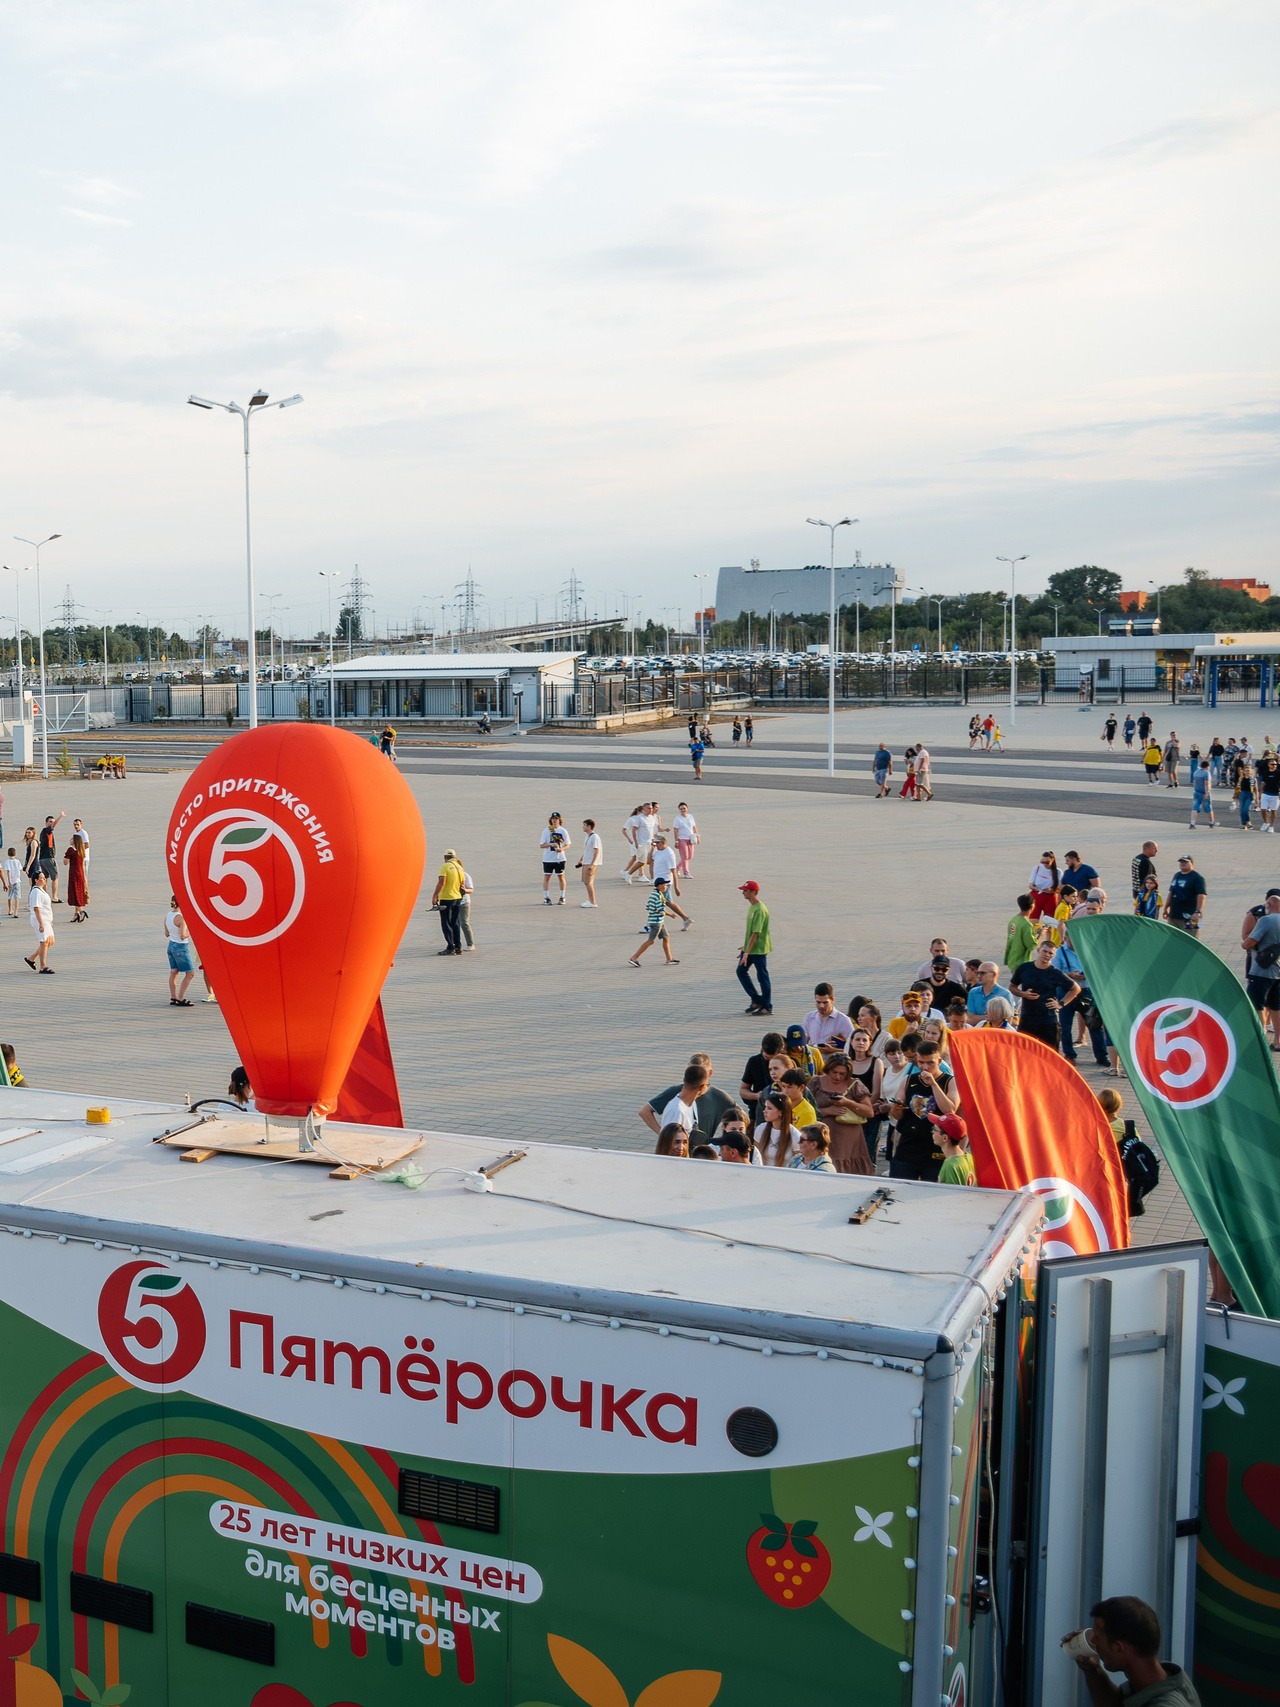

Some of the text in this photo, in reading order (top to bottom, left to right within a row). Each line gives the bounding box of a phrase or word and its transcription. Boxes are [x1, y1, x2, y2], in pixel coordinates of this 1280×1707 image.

[169, 777, 335, 864] Место притяжения
[229, 1308, 698, 1446] Пятёрочка
[219, 1504, 526, 1594] 25 лет низких цен
[244, 1548, 502, 1633] для бесценных
[285, 1591, 457, 1651] моментов
